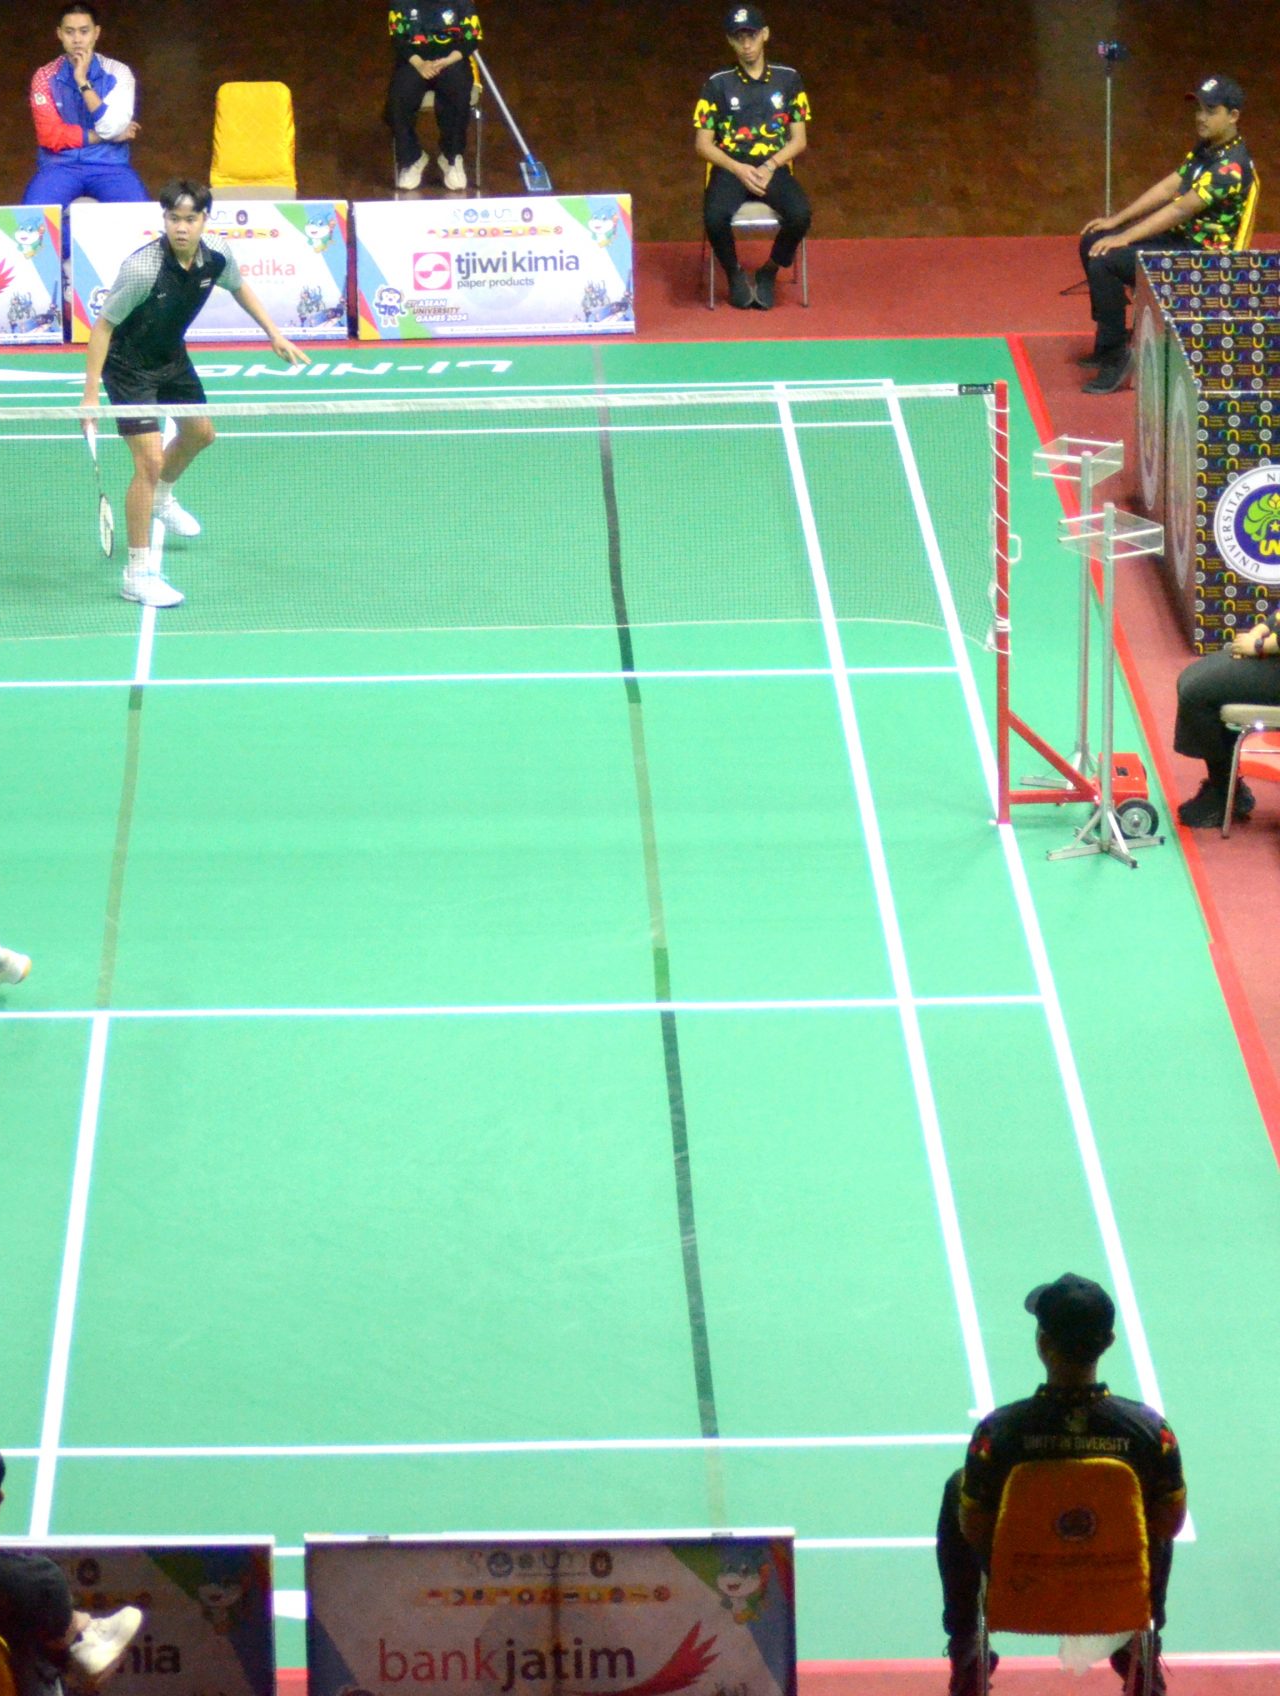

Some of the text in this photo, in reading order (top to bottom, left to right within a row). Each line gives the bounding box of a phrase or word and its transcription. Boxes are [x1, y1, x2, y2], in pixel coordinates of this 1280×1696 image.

[239, 257, 296, 277] edika
[457, 276, 535, 289] paper products
[416, 314, 445, 322] GAMES
[1222, 483, 1261, 573] UNIVERSITAS
[1074, 1435, 1130, 1452] DIVERSITY
